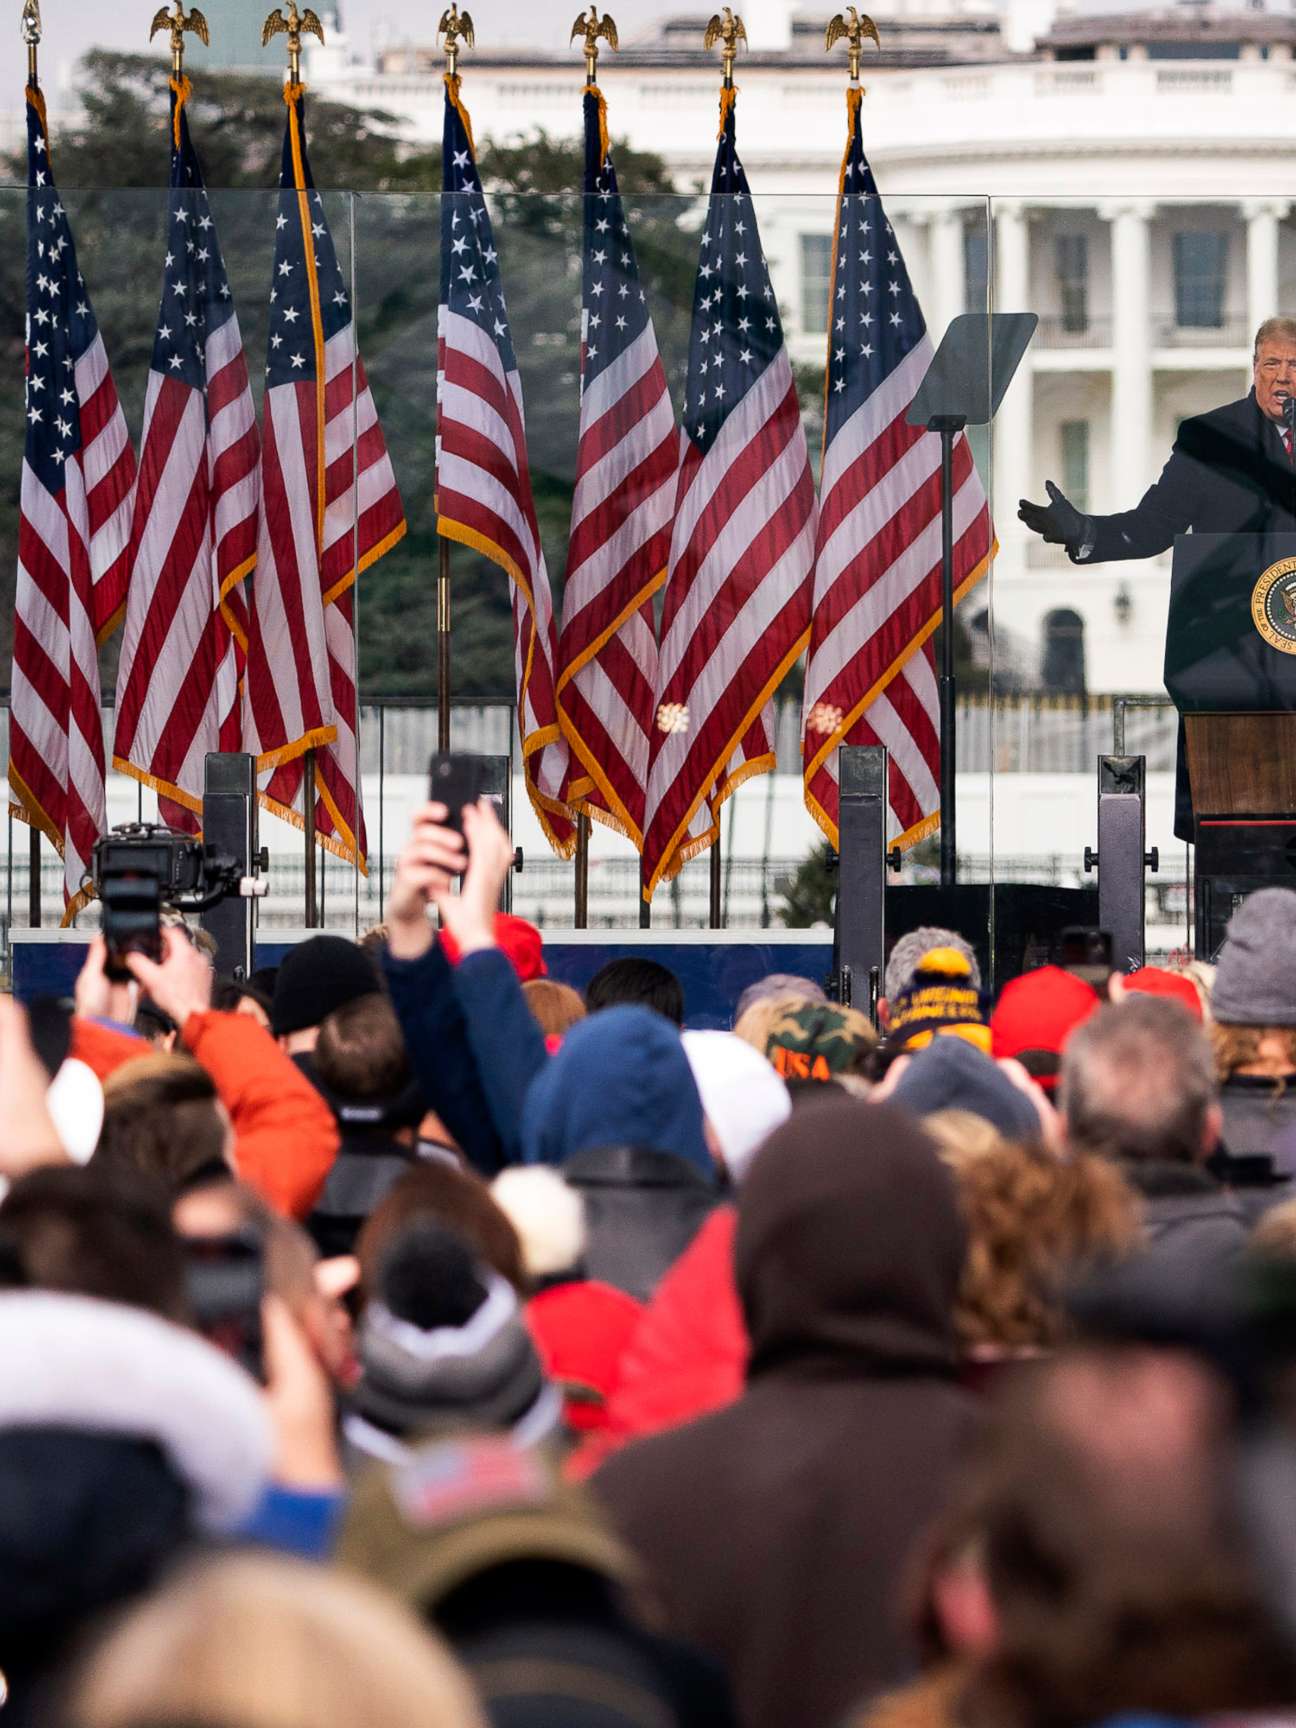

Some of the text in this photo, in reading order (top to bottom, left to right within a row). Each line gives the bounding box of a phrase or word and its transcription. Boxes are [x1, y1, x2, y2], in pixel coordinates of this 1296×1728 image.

[1255, 608, 1263, 621] THE
[1269, 631, 1294, 650] SEAL
[774, 1046, 830, 1081] USA
